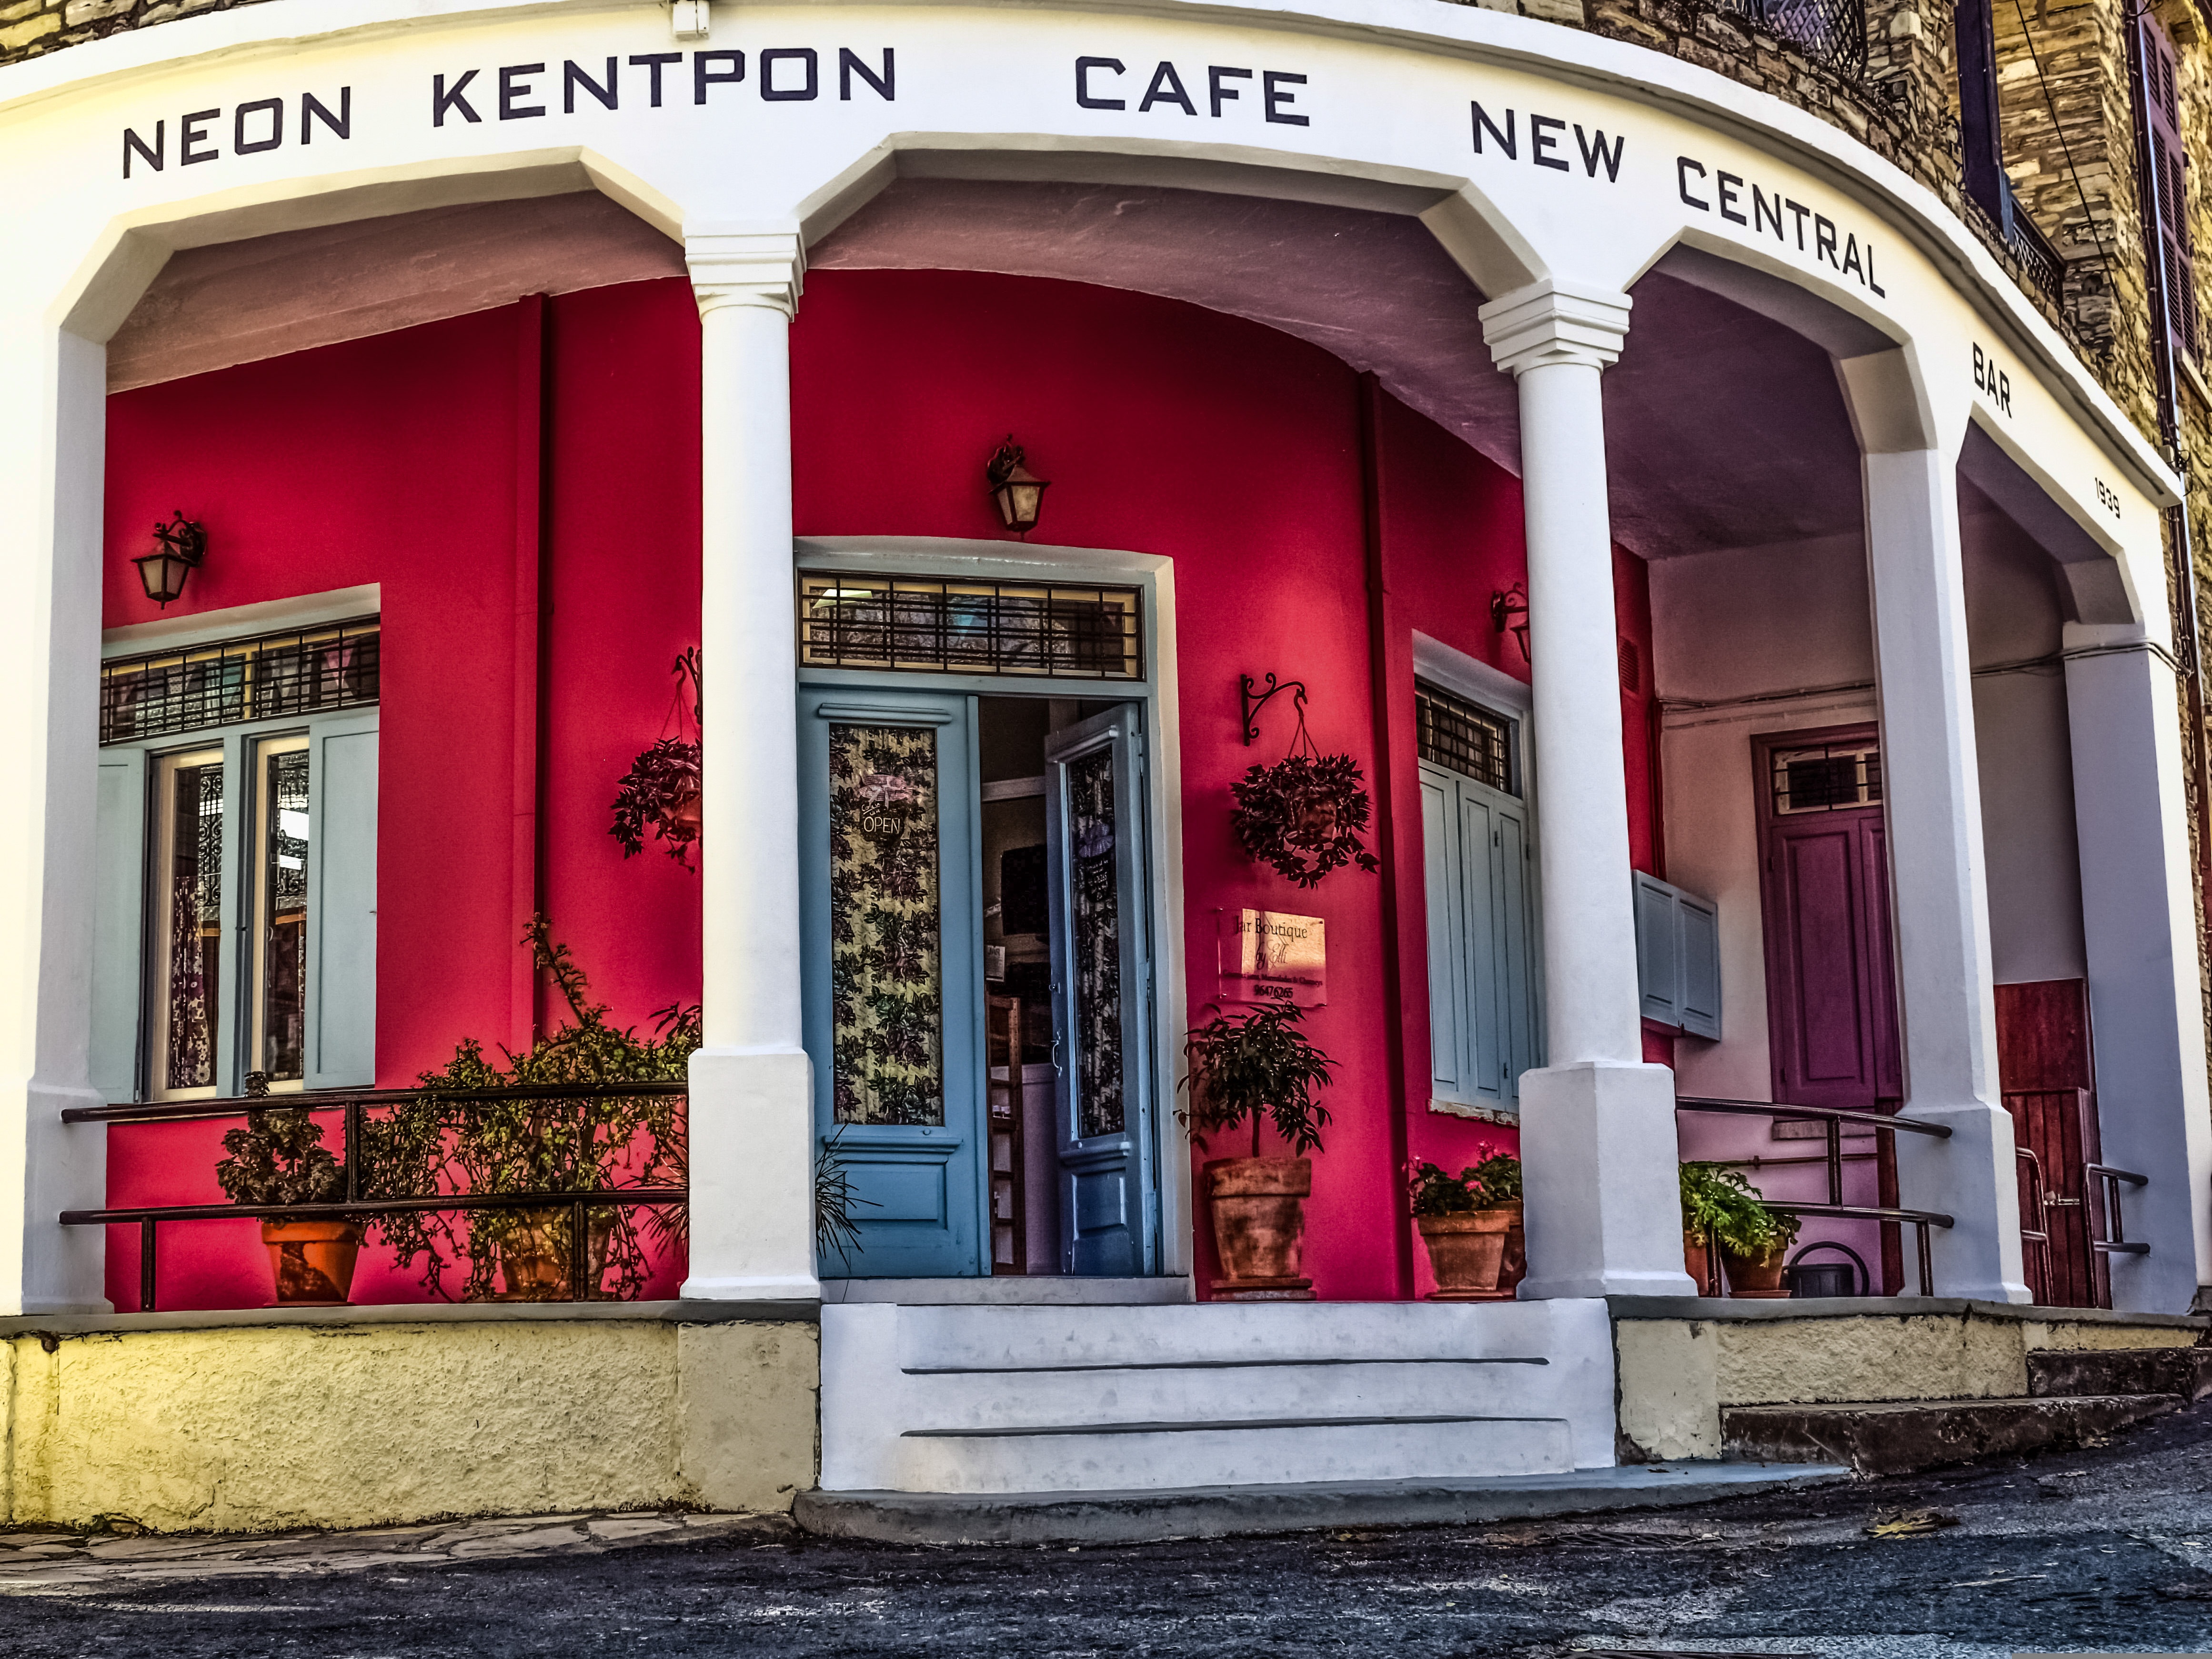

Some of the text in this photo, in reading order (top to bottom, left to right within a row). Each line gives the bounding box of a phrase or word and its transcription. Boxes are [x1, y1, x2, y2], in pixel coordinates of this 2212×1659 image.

[1075, 56, 2121, 519] CAFE NEW CENTRAL BAR 1939
[864, 816, 900, 834] OPEN
[1255, 918, 1307, 942] Boutique
[1254, 984, 1293, 998] 96476265
